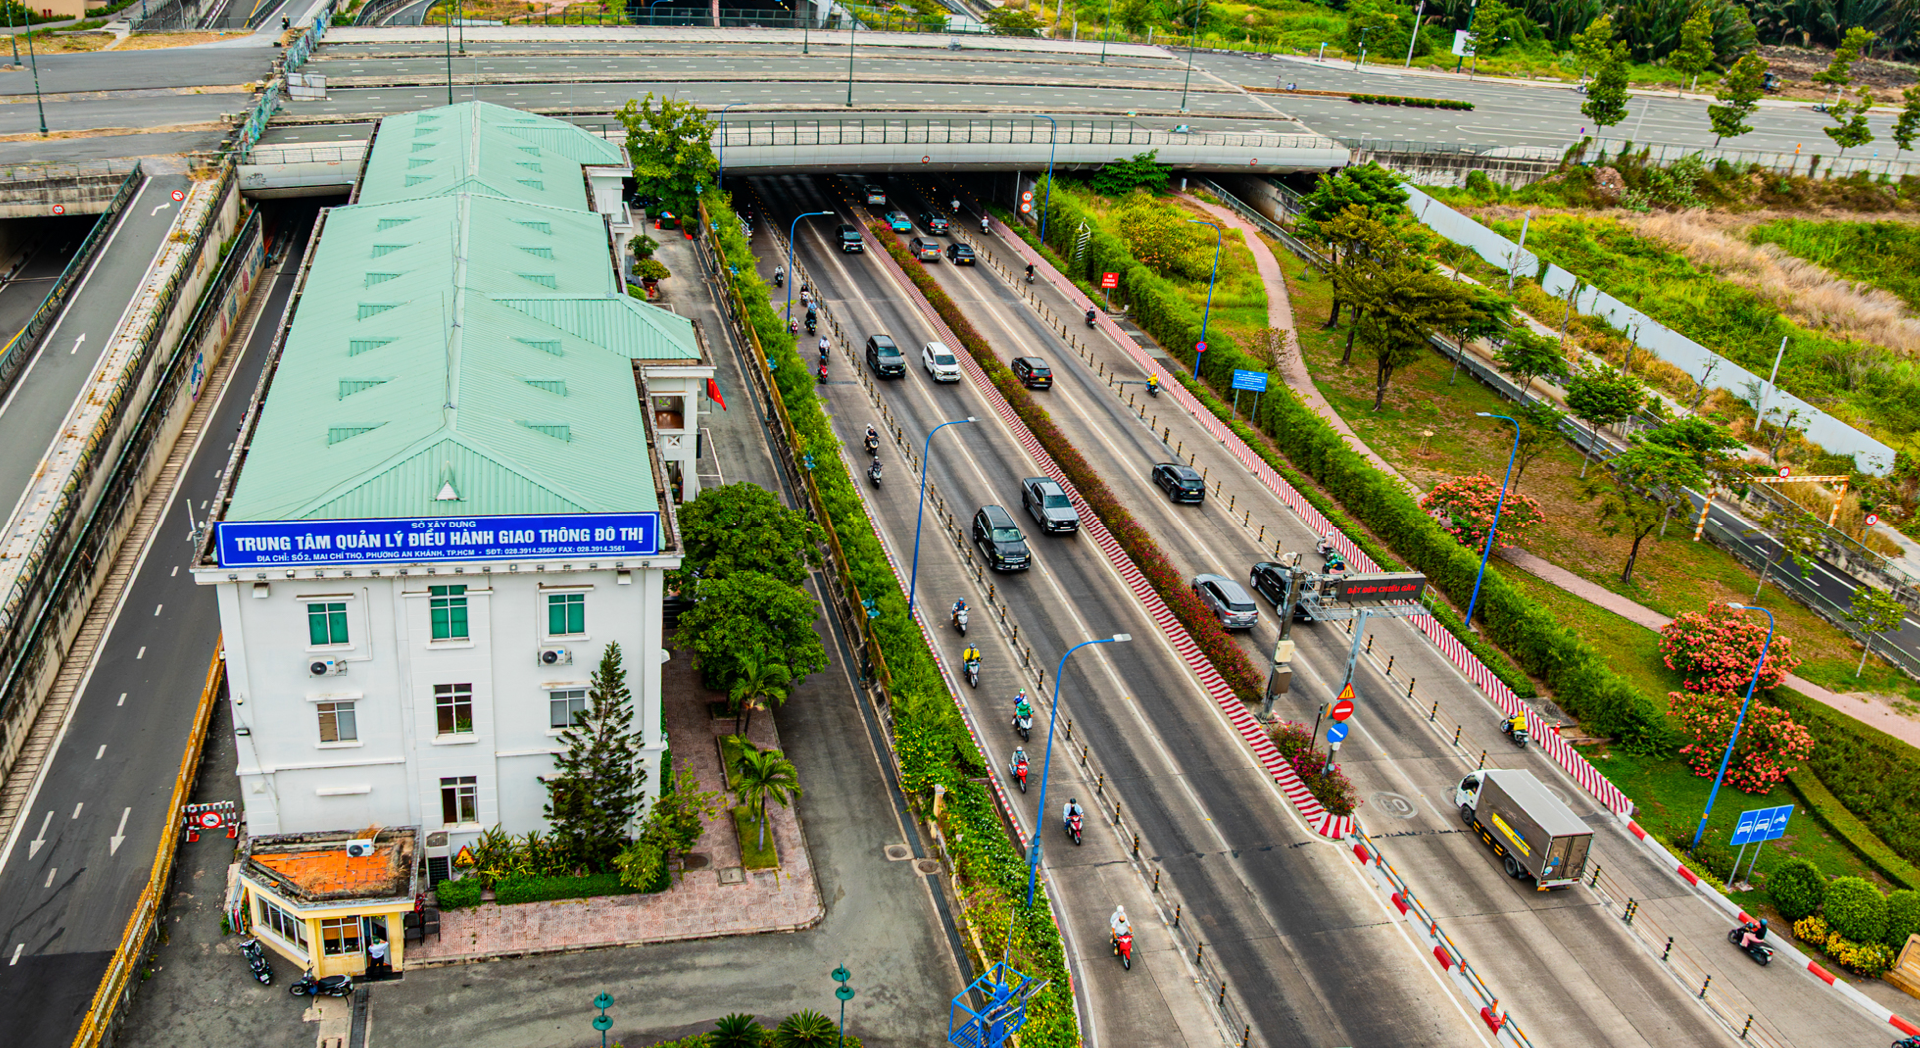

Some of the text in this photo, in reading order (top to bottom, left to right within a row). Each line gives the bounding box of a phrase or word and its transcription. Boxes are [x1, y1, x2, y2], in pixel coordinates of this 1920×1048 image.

[411, 520, 477, 529] SỞ XÂY DỰNG
[234, 525, 644, 552] TRUNG TÂM QUẢN LÝ ĐIỀU HÀNH GIAO THÔNG ĐÔ THỊ
[256, 554, 271, 563] ĐỊA
[329, 550, 344, 560] CHÍ
[345, 552, 364, 560] THỌ,
[401, 550, 413, 558] AN
[414, 548, 445, 558] KHÁNH,
[446, 549, 475, 557] TP.HCM
